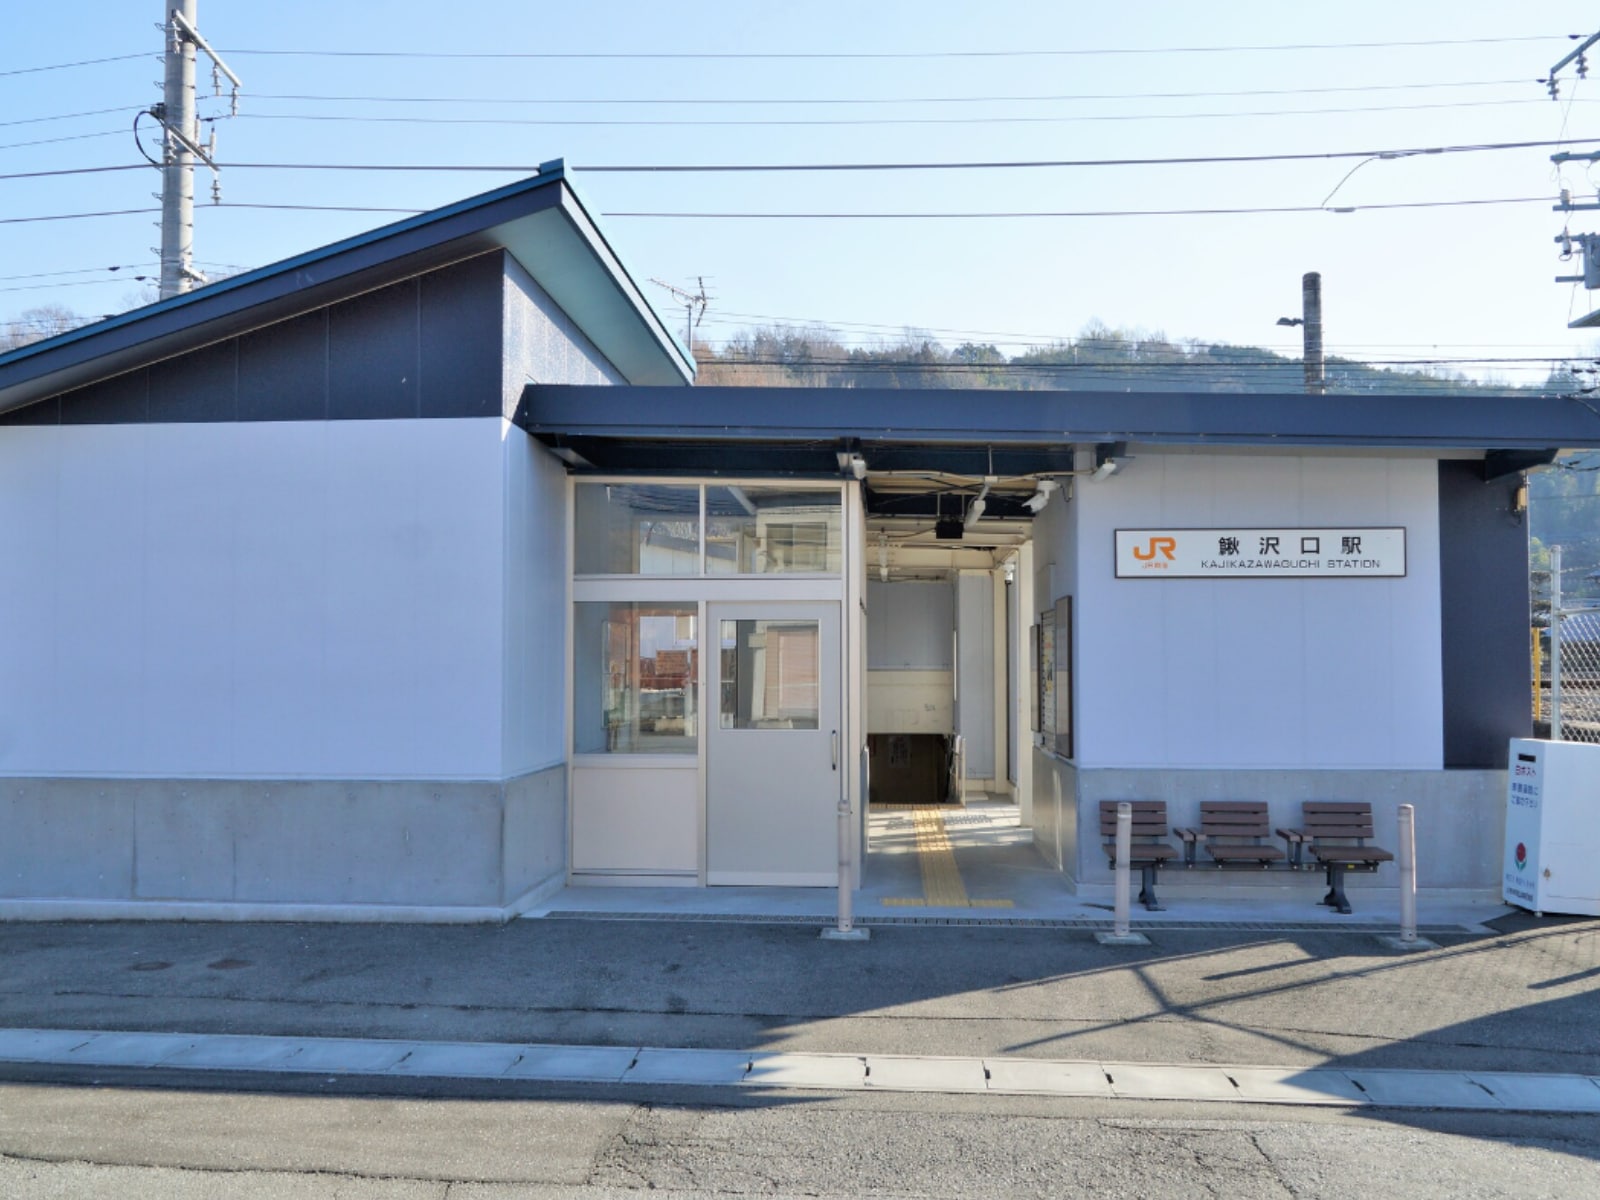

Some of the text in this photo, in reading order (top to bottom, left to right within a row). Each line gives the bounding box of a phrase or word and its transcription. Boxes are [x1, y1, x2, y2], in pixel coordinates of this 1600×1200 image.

[1133, 537, 1176, 560] JR
[1218, 536, 1362, 555] 鰍沢口駅
[1201, 560, 1380, 568] KAJIKAZAWAGUCHI STATION
